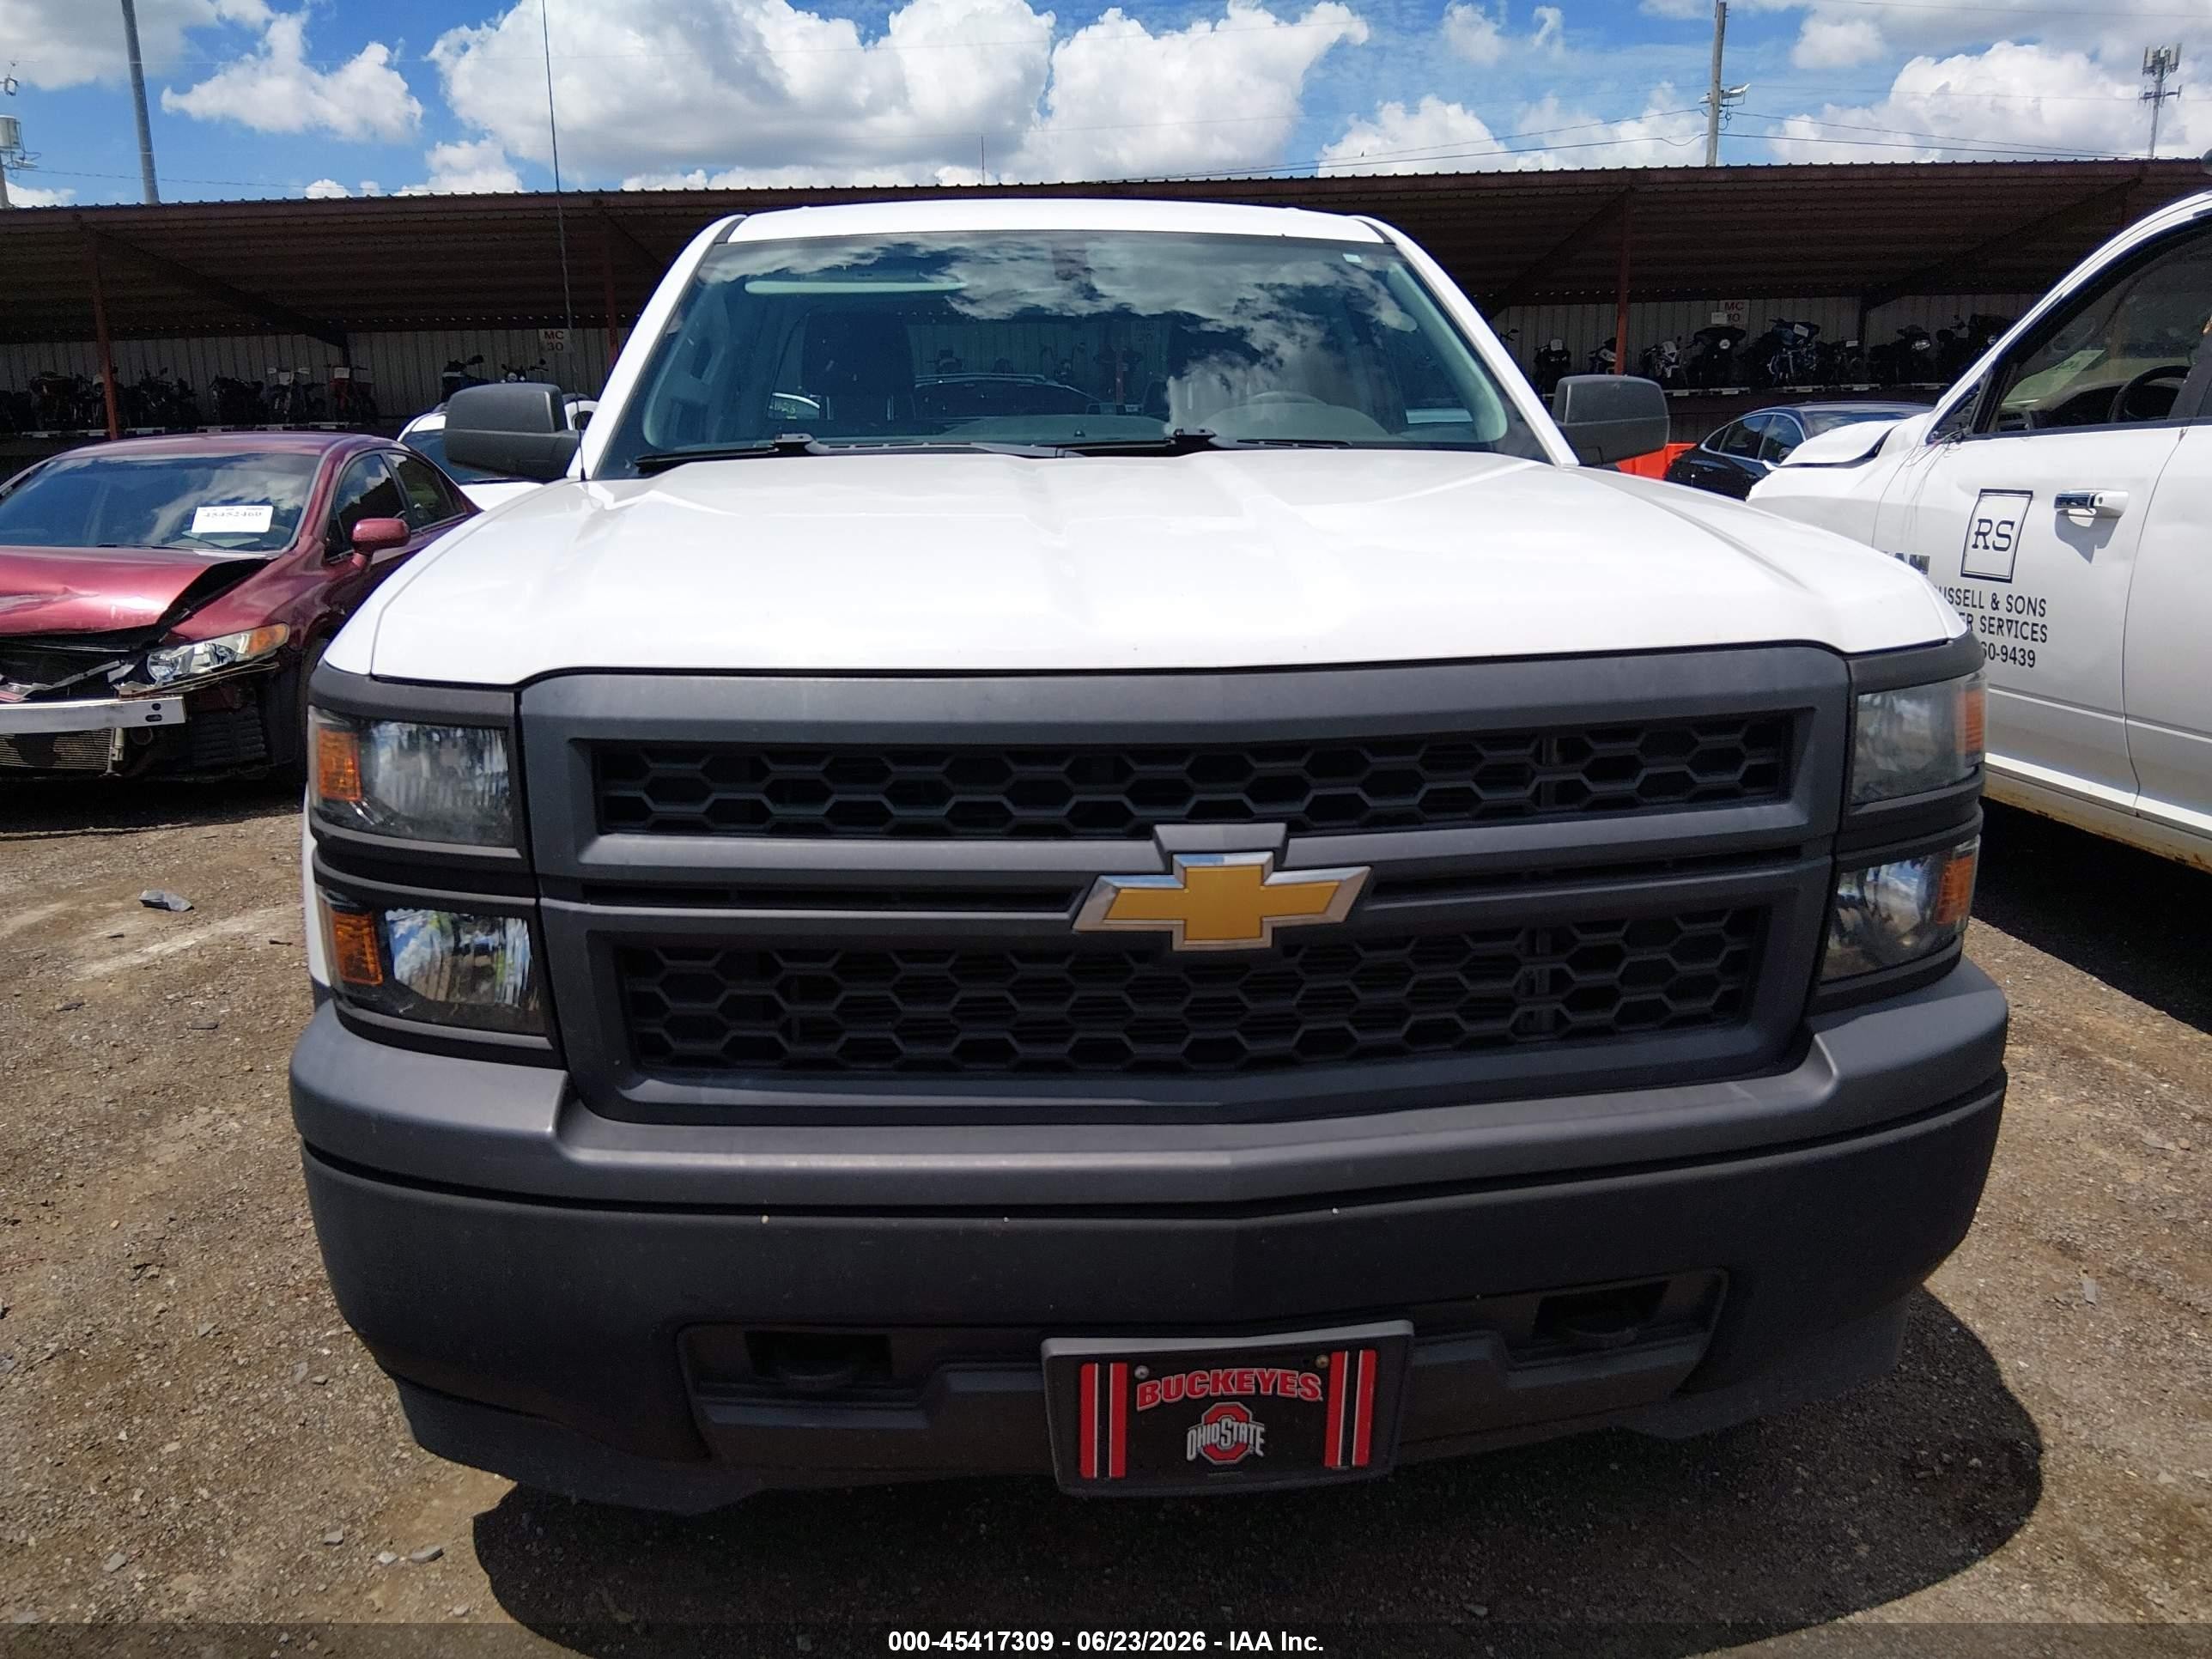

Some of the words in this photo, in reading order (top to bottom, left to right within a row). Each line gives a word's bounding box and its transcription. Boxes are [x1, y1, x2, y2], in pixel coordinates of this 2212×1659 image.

[1725, 301, 1744, 310] MC
[544, 331, 564, 339] MC
[1972, 519, 2015, 552] RS
[1934, 585, 1984, 610] SSELL
[1990, 592, 2000, 611] &
[2006, 594, 2047, 617] SONS
[1979, 615, 2048, 643] SERVICES
[1137, 1368, 1322, 1412] BUCKEYES
